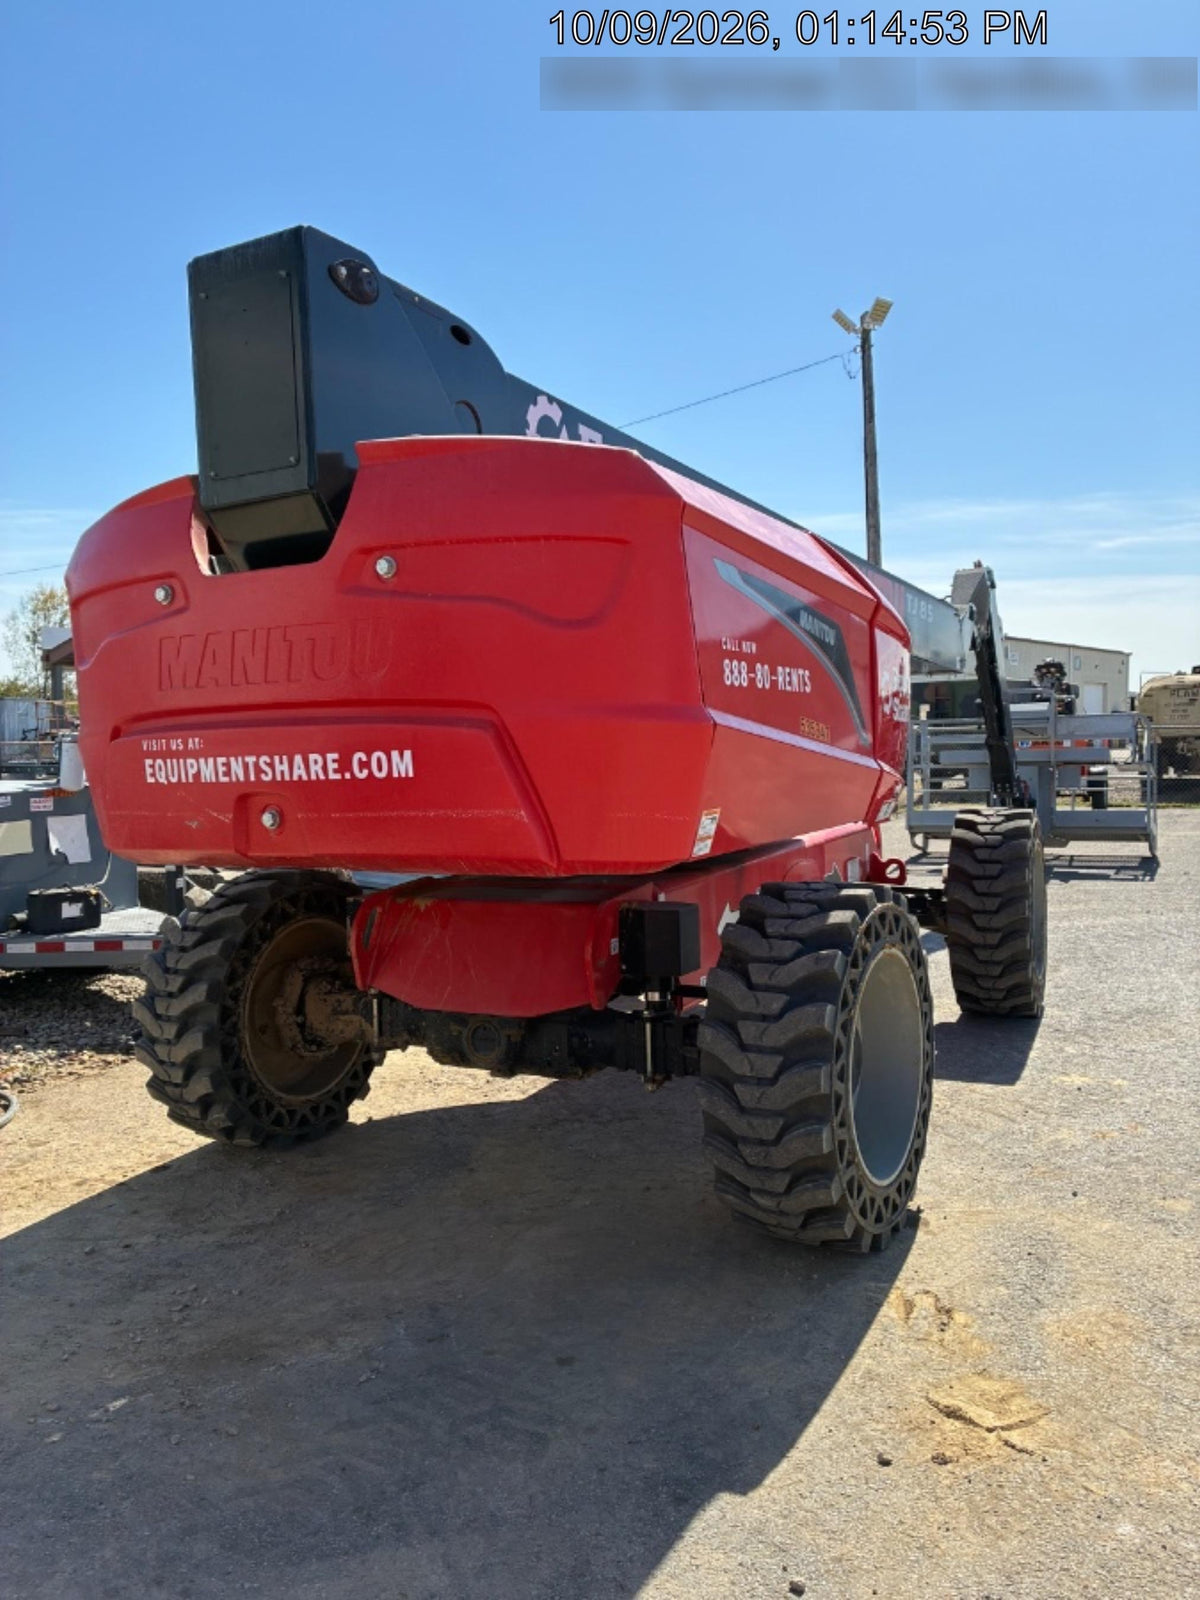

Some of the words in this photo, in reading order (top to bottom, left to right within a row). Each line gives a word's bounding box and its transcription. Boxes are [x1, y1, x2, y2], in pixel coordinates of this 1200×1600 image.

[158, 617, 394, 692] MANITOU
[720, 636, 740, 652] CALL
[742, 640, 757, 654] NOW
[722, 657, 812, 694] 888-80-RENTS
[141, 738, 167, 751] VISIT
[169, 737, 184, 751] US
[187, 737, 205, 750] AT:
[143, 749, 415, 785] EQUIPMENTSHARE.COM
